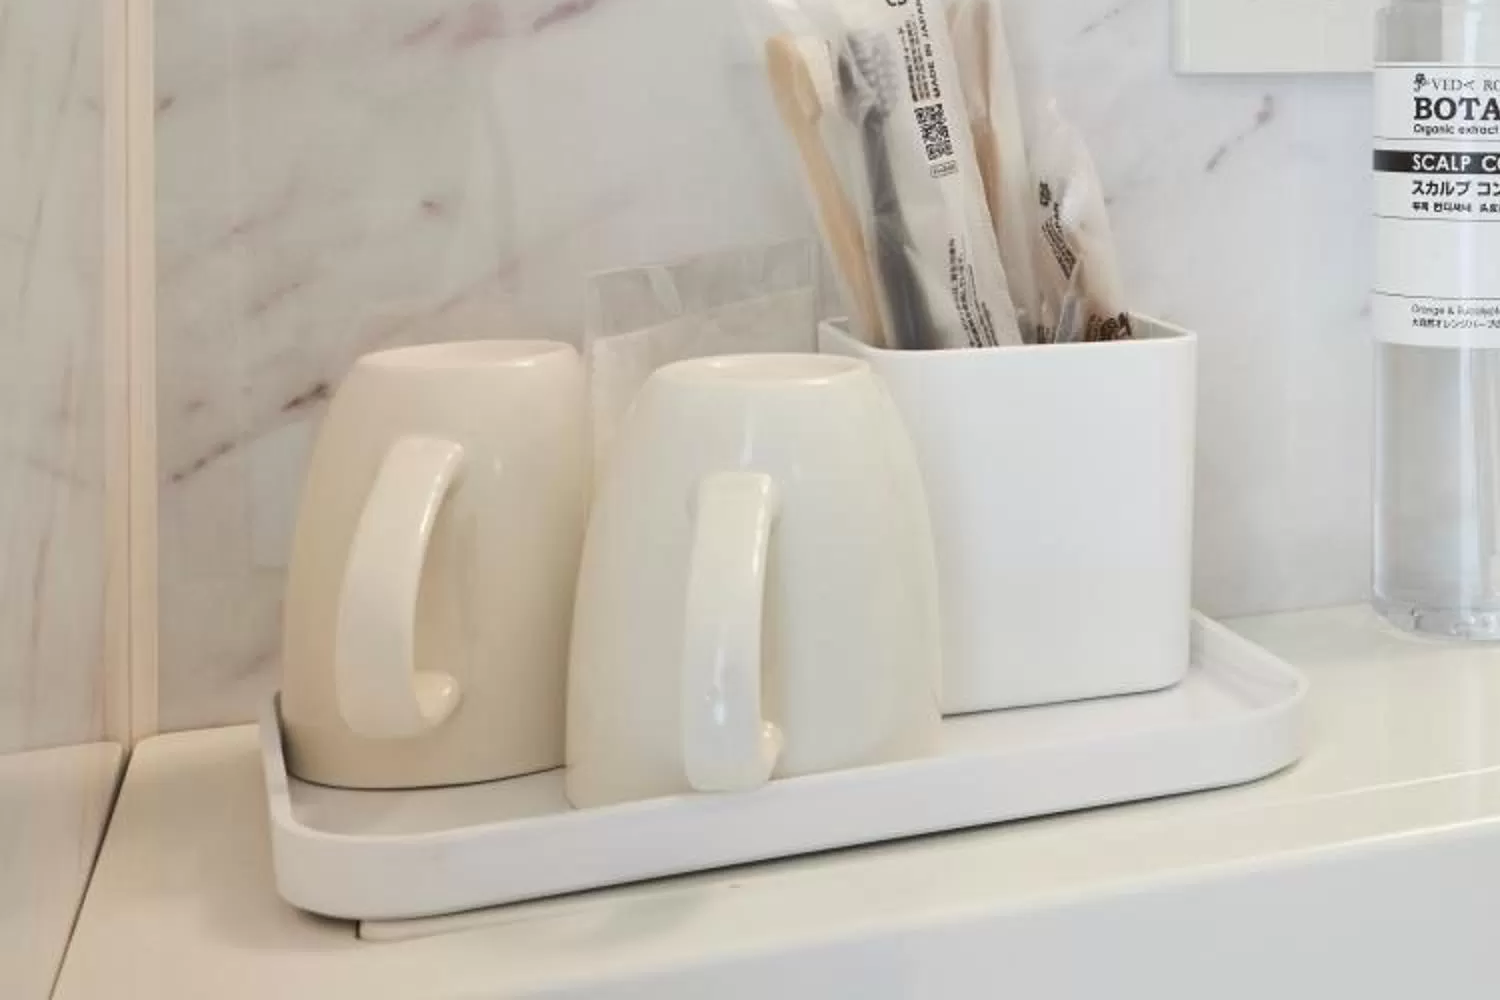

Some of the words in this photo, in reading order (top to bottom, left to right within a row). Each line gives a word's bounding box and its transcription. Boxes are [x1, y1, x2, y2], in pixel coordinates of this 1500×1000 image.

[924, 43, 933, 57] IN
[927, 60, 941, 98] MADE
[1413, 123, 1454, 136] Organic
[1458, 124, 1498, 135] extract
[1412, 154, 1471, 171] SCALP
[1412, 180, 1471, 196] スカルプ
